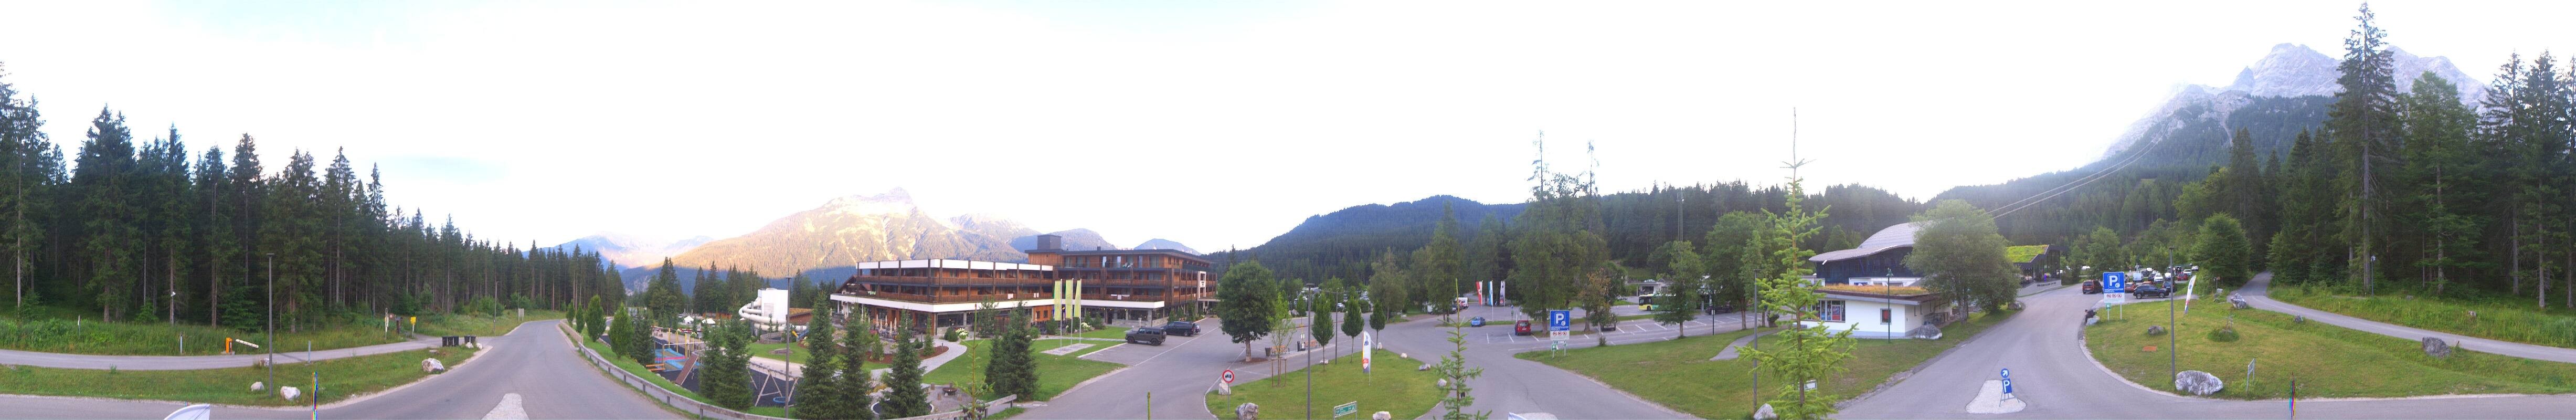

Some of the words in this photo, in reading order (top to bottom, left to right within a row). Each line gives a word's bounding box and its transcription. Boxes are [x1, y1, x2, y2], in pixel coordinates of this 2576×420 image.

[2109, 275, 2118, 287] P
[1555, 313, 1564, 324] P
[2003, 379, 2010, 393] P
